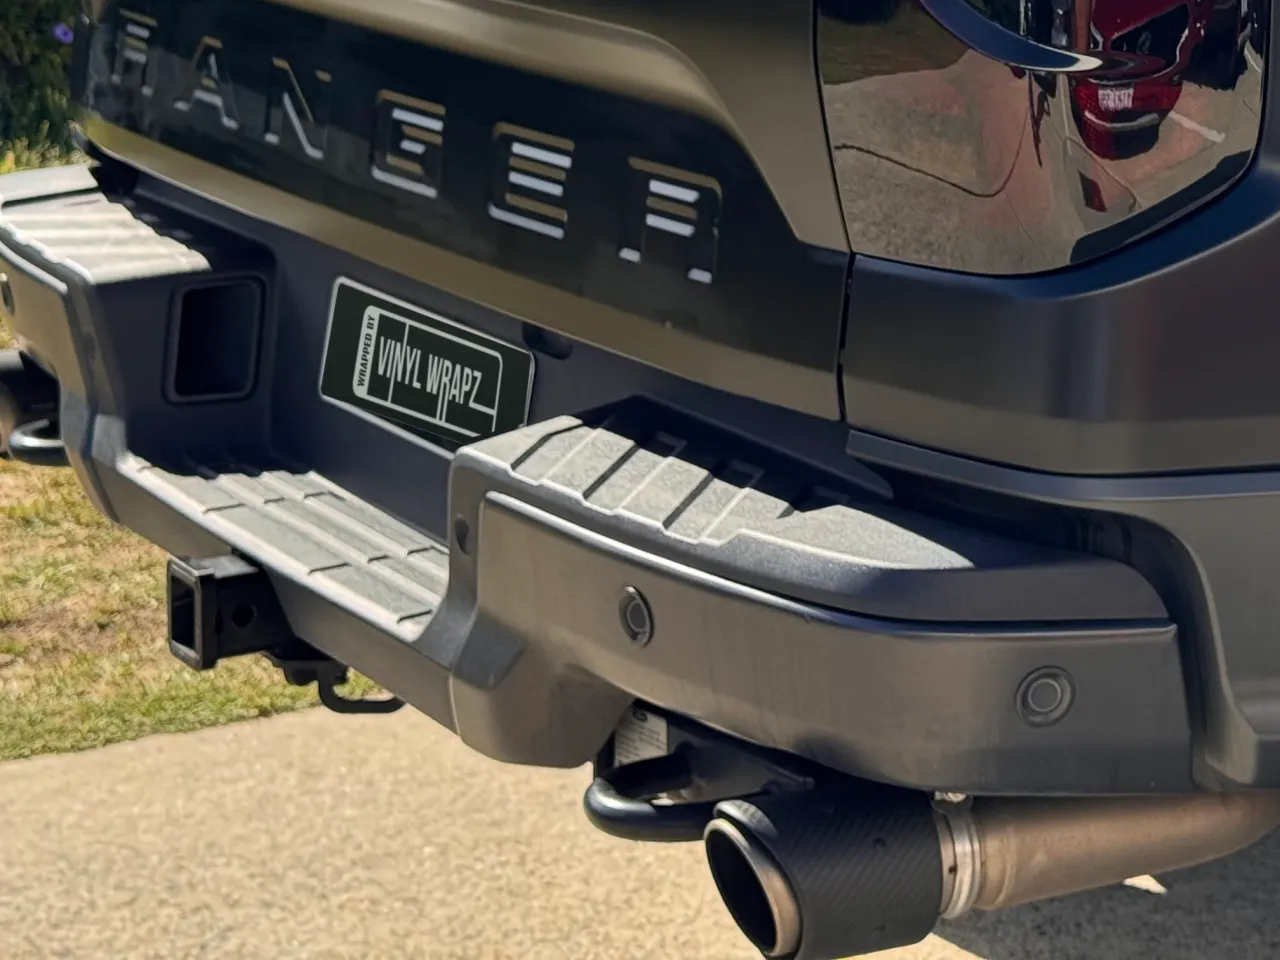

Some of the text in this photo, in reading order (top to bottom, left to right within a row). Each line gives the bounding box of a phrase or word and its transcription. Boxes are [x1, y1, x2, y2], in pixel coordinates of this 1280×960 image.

[104, 9, 723, 284] RANGER
[357, 314, 376, 387] WRAPPED BY
[377, 333, 490, 416] VINYL WRAPZ
